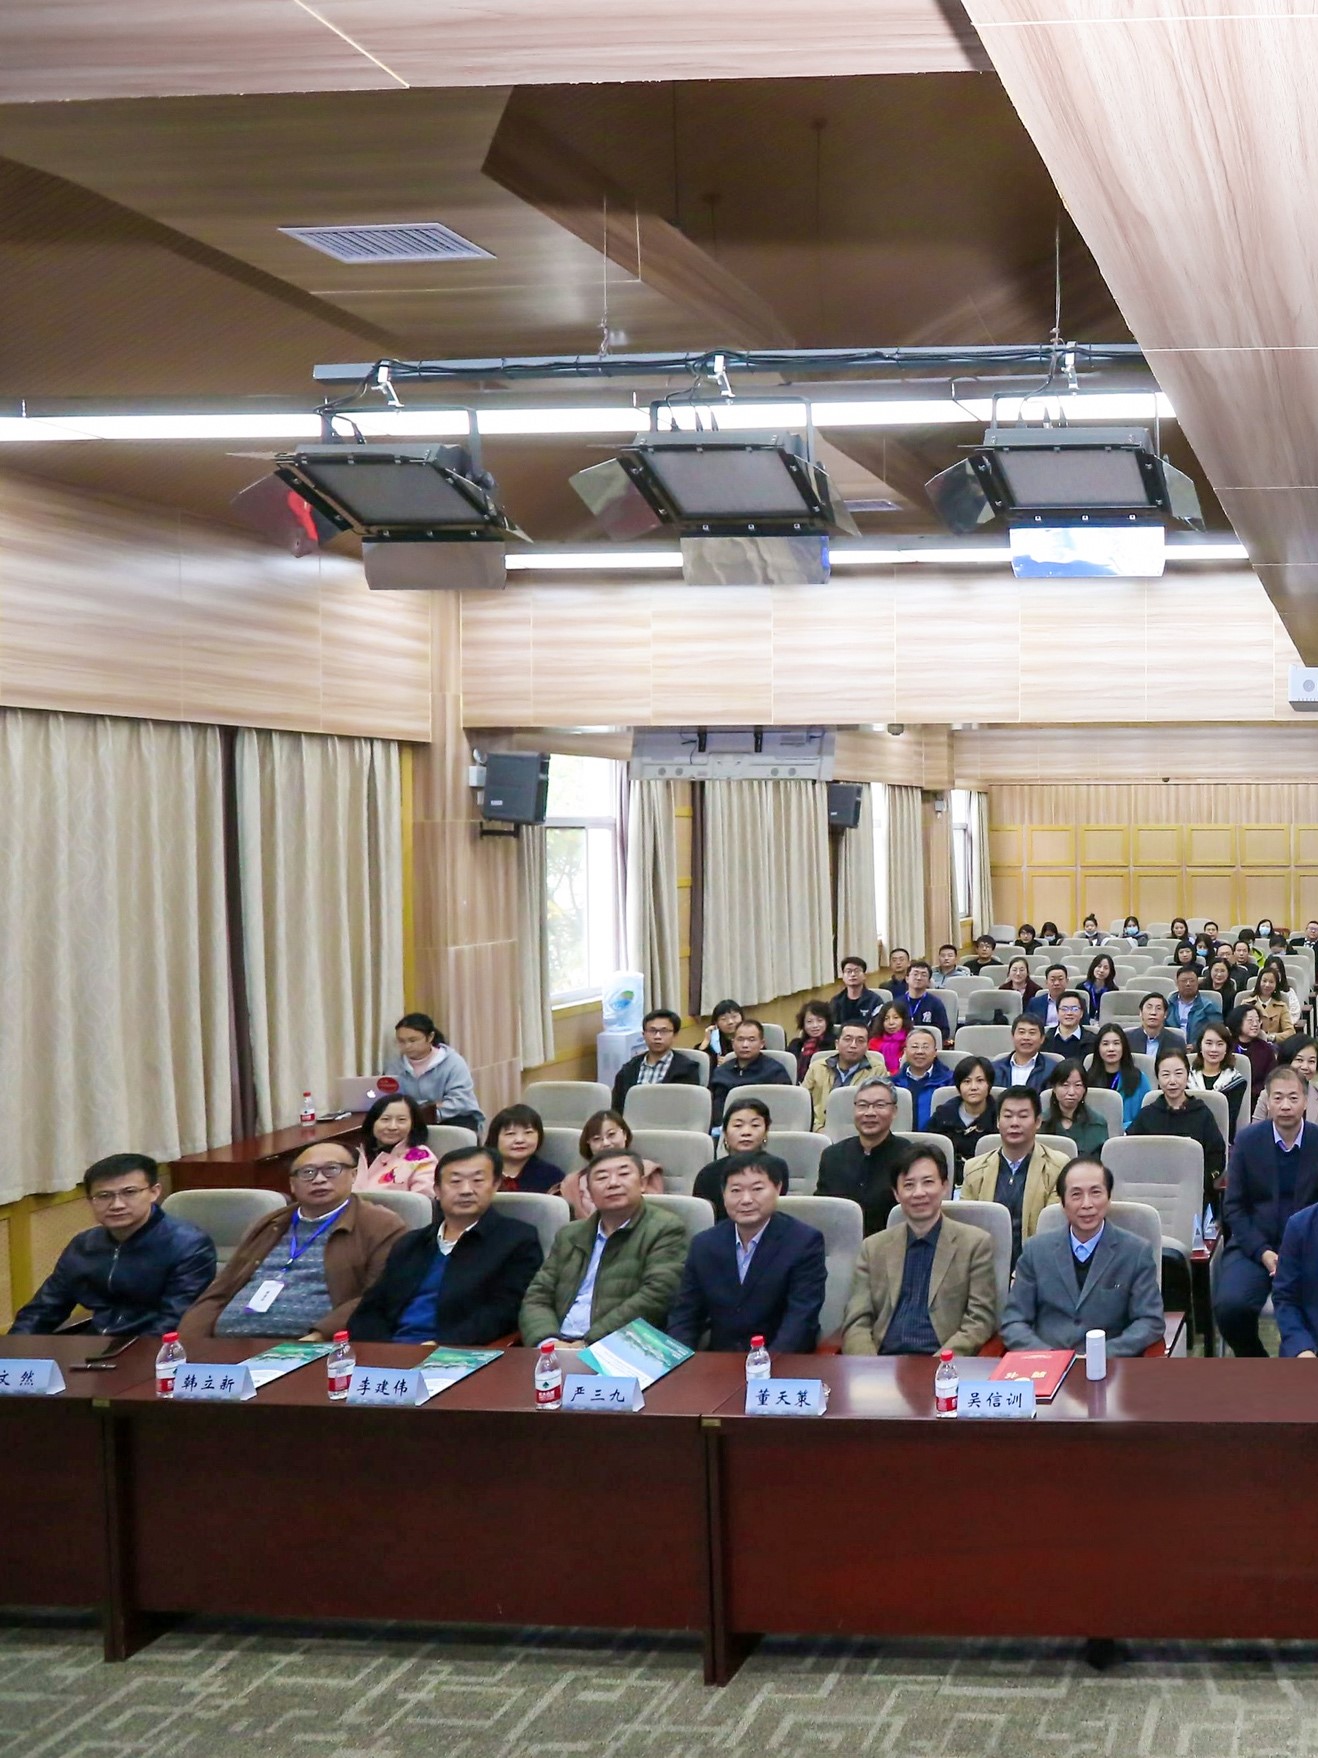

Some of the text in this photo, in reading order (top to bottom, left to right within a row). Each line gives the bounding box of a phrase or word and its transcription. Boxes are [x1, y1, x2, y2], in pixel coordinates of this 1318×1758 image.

[181, 1374, 236, 1392] 韩立新
[356, 1376, 409, 1397] 李建伟
[570, 1386, 626, 1403] 严三九
[756, 1387, 811, 1408] 董天策
[969, 1391, 1022, 1408] 吴信训
